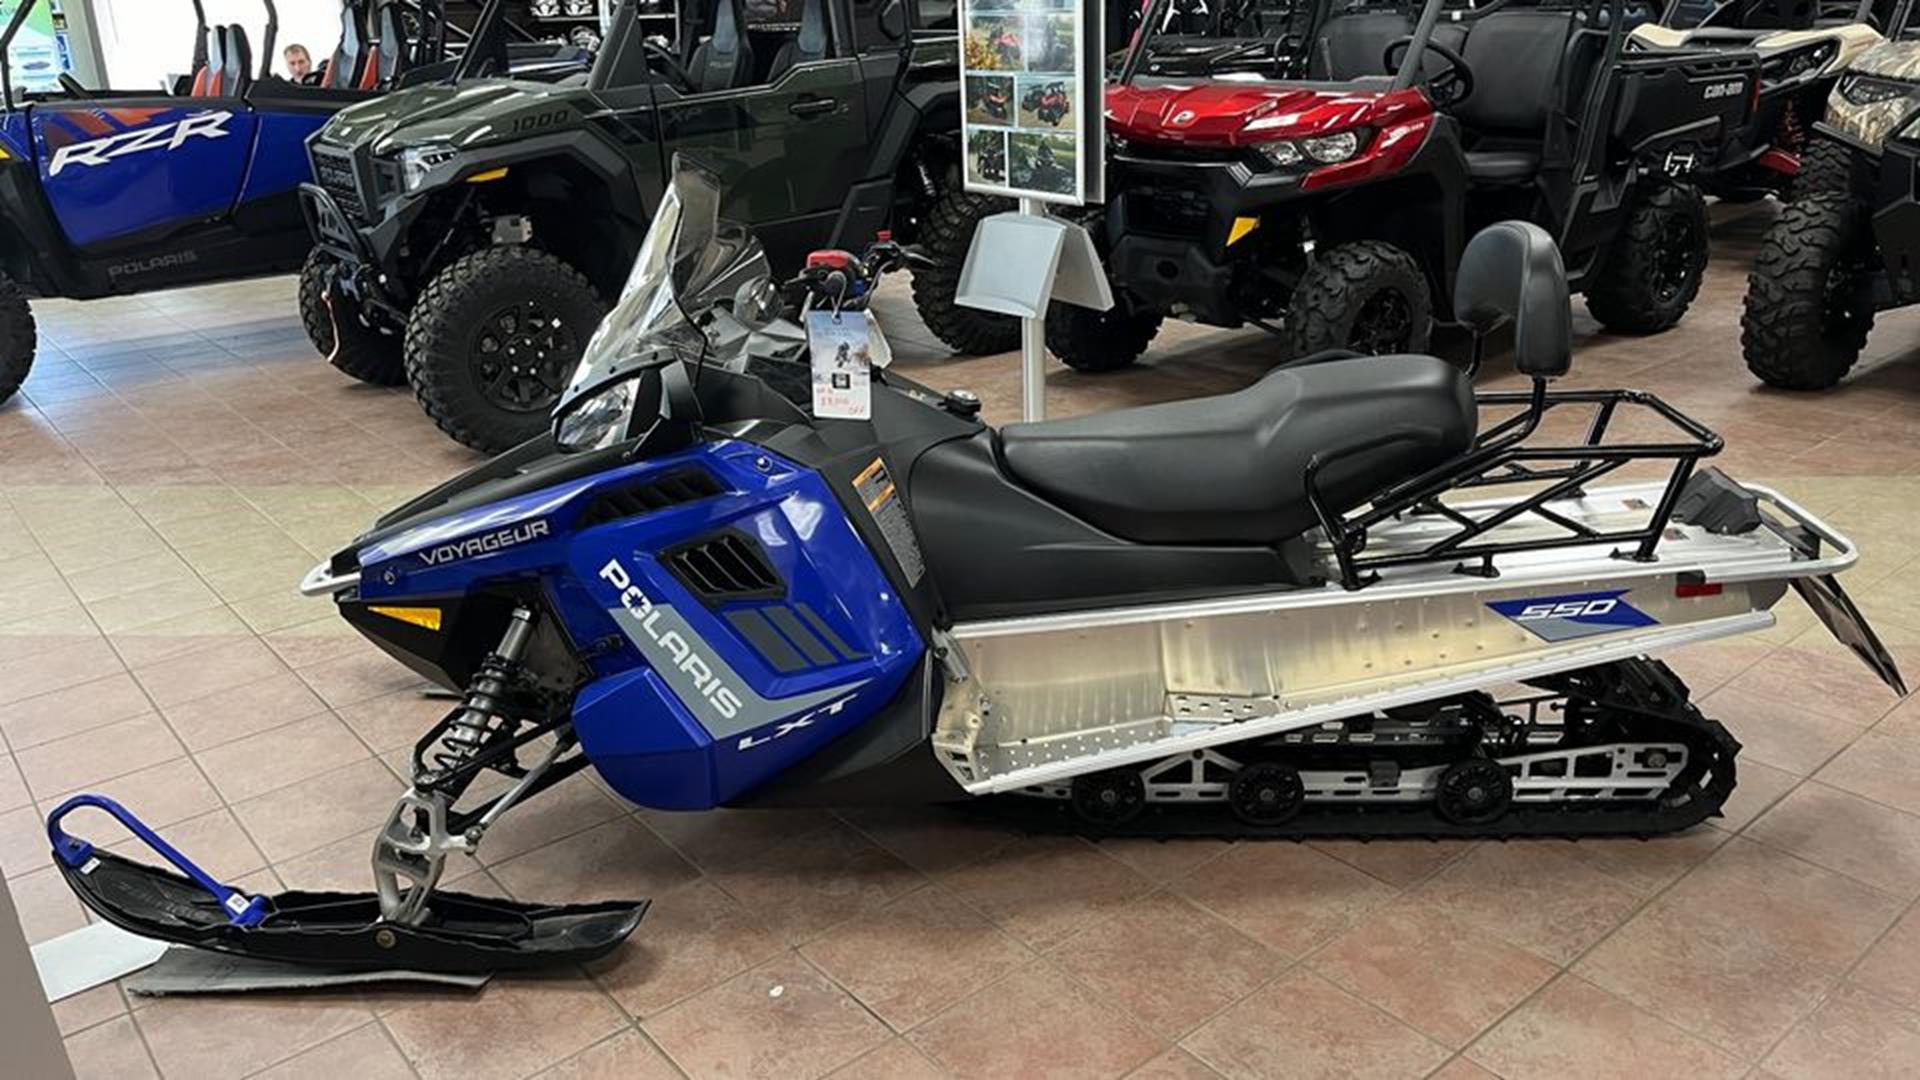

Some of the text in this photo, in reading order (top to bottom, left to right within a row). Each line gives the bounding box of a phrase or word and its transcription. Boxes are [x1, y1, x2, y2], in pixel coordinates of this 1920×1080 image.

[50, 111, 233, 176] RZR
[513, 109, 569, 133] 1000
[107, 250, 198, 282] POLARIS
[419, 519, 549, 566] VOYAGEUR
[1516, 599, 1618, 621] 550
[599, 558, 743, 720] POLARIS
[737, 693, 858, 751] LXT
